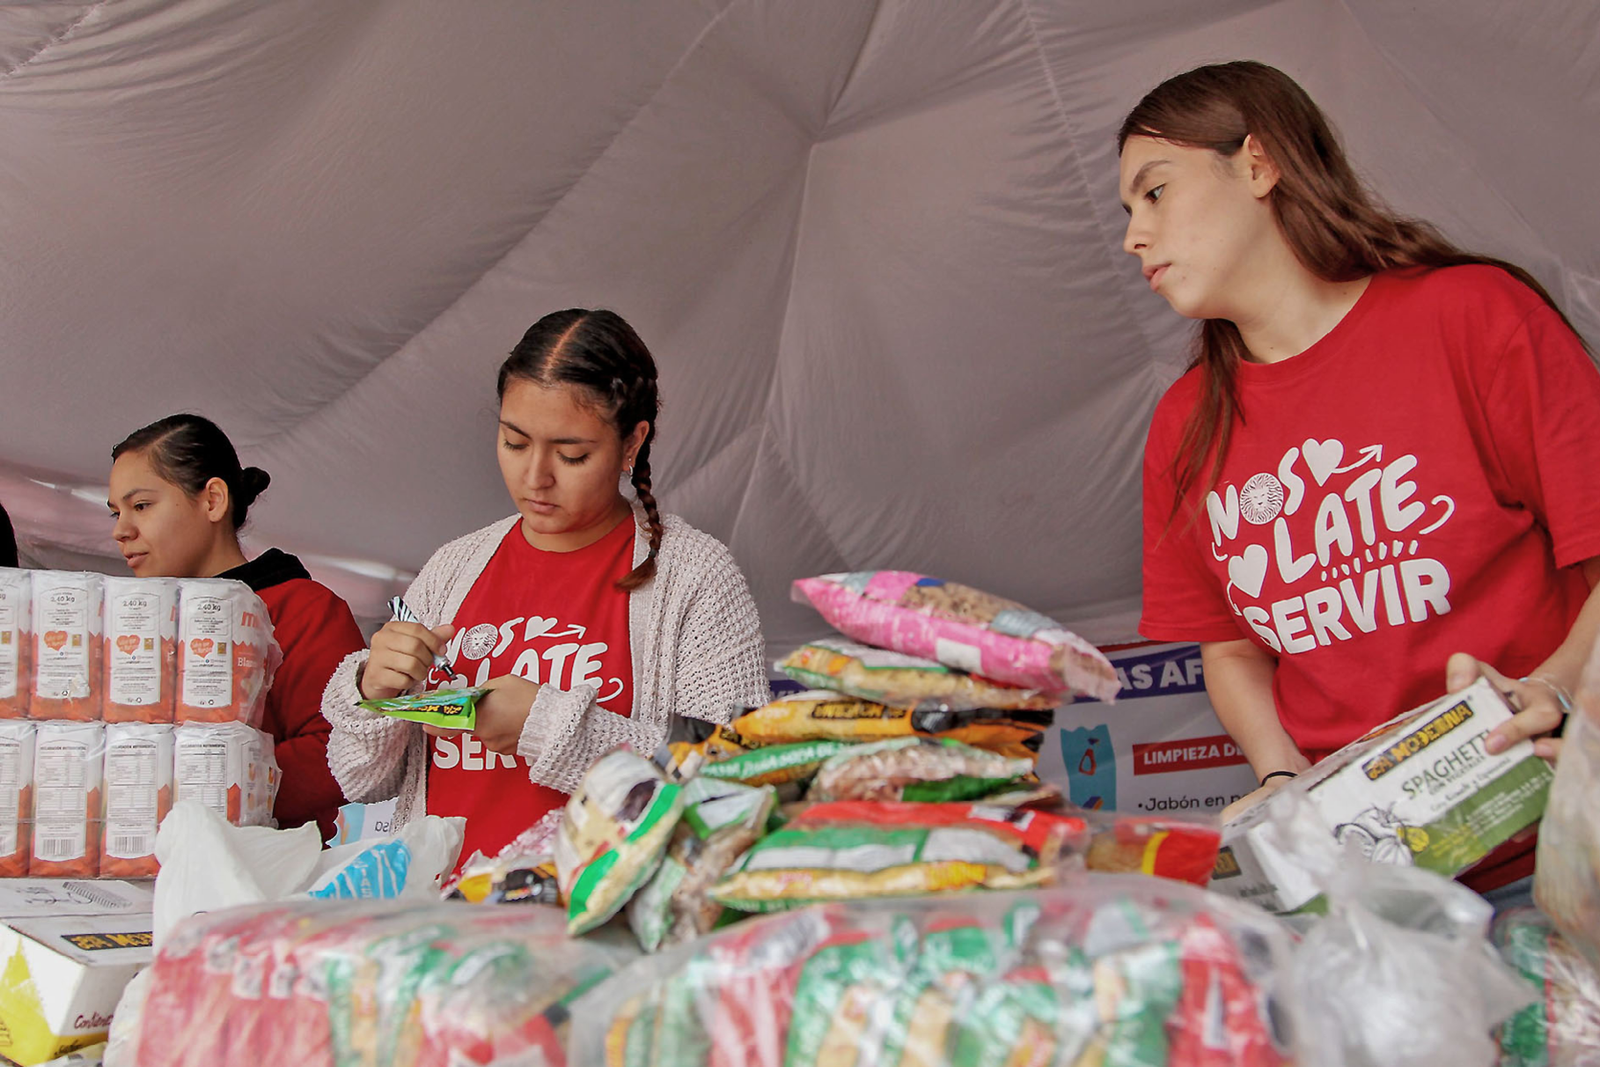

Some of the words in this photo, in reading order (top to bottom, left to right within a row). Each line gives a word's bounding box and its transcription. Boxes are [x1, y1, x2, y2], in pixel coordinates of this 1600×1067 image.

[1207, 447, 1305, 547] NOS
[1274, 454, 1426, 584] LATE
[1242, 558, 1452, 655] SERVIR
[1143, 745, 1221, 766] LIMPIEZA
[1392, 703, 1474, 761] MODERNA
[1402, 729, 1490, 800] SPAGHETT
[1145, 795, 1200, 811] Jabón
[1204, 796, 1225, 807] en
